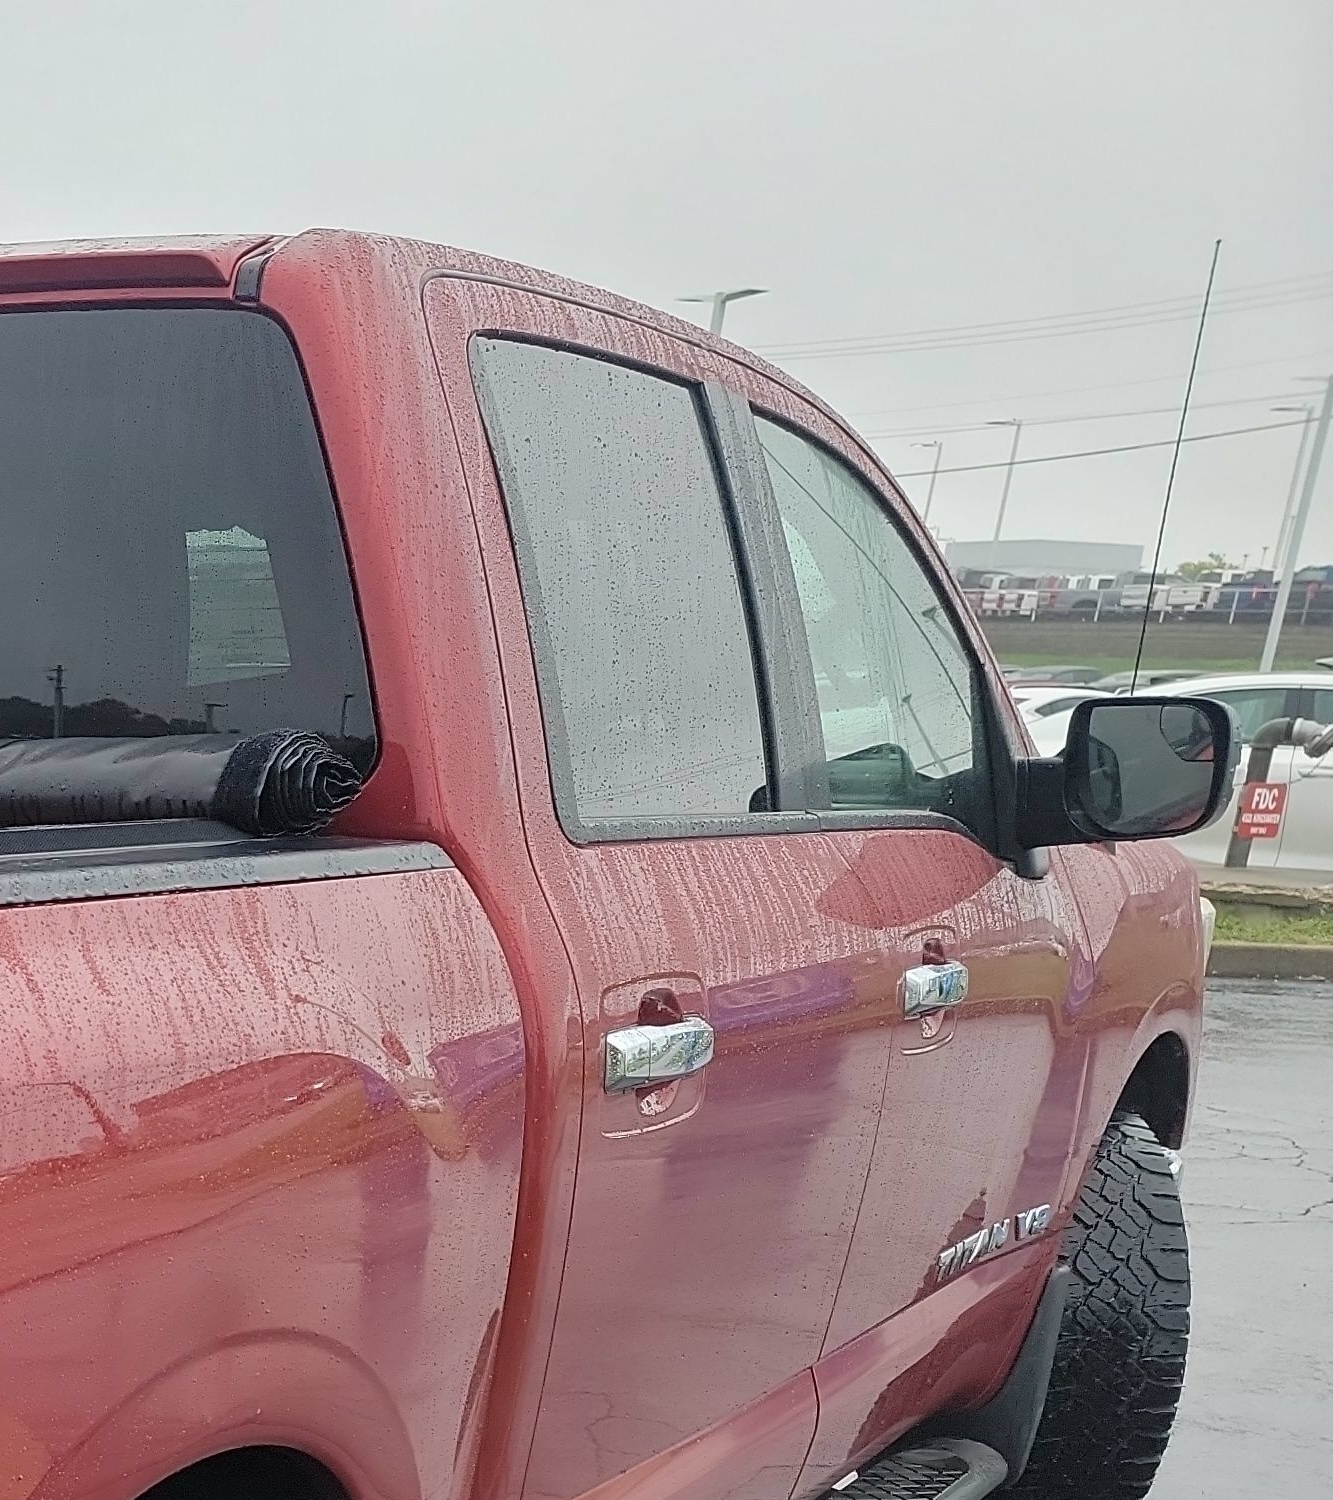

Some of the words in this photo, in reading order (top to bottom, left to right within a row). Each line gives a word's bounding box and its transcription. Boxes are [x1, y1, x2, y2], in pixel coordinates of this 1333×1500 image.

[1251, 788, 1279, 811] FDC
[935, 1218, 1011, 1282] TITAN
[1015, 1204, 1050, 1241] V8
